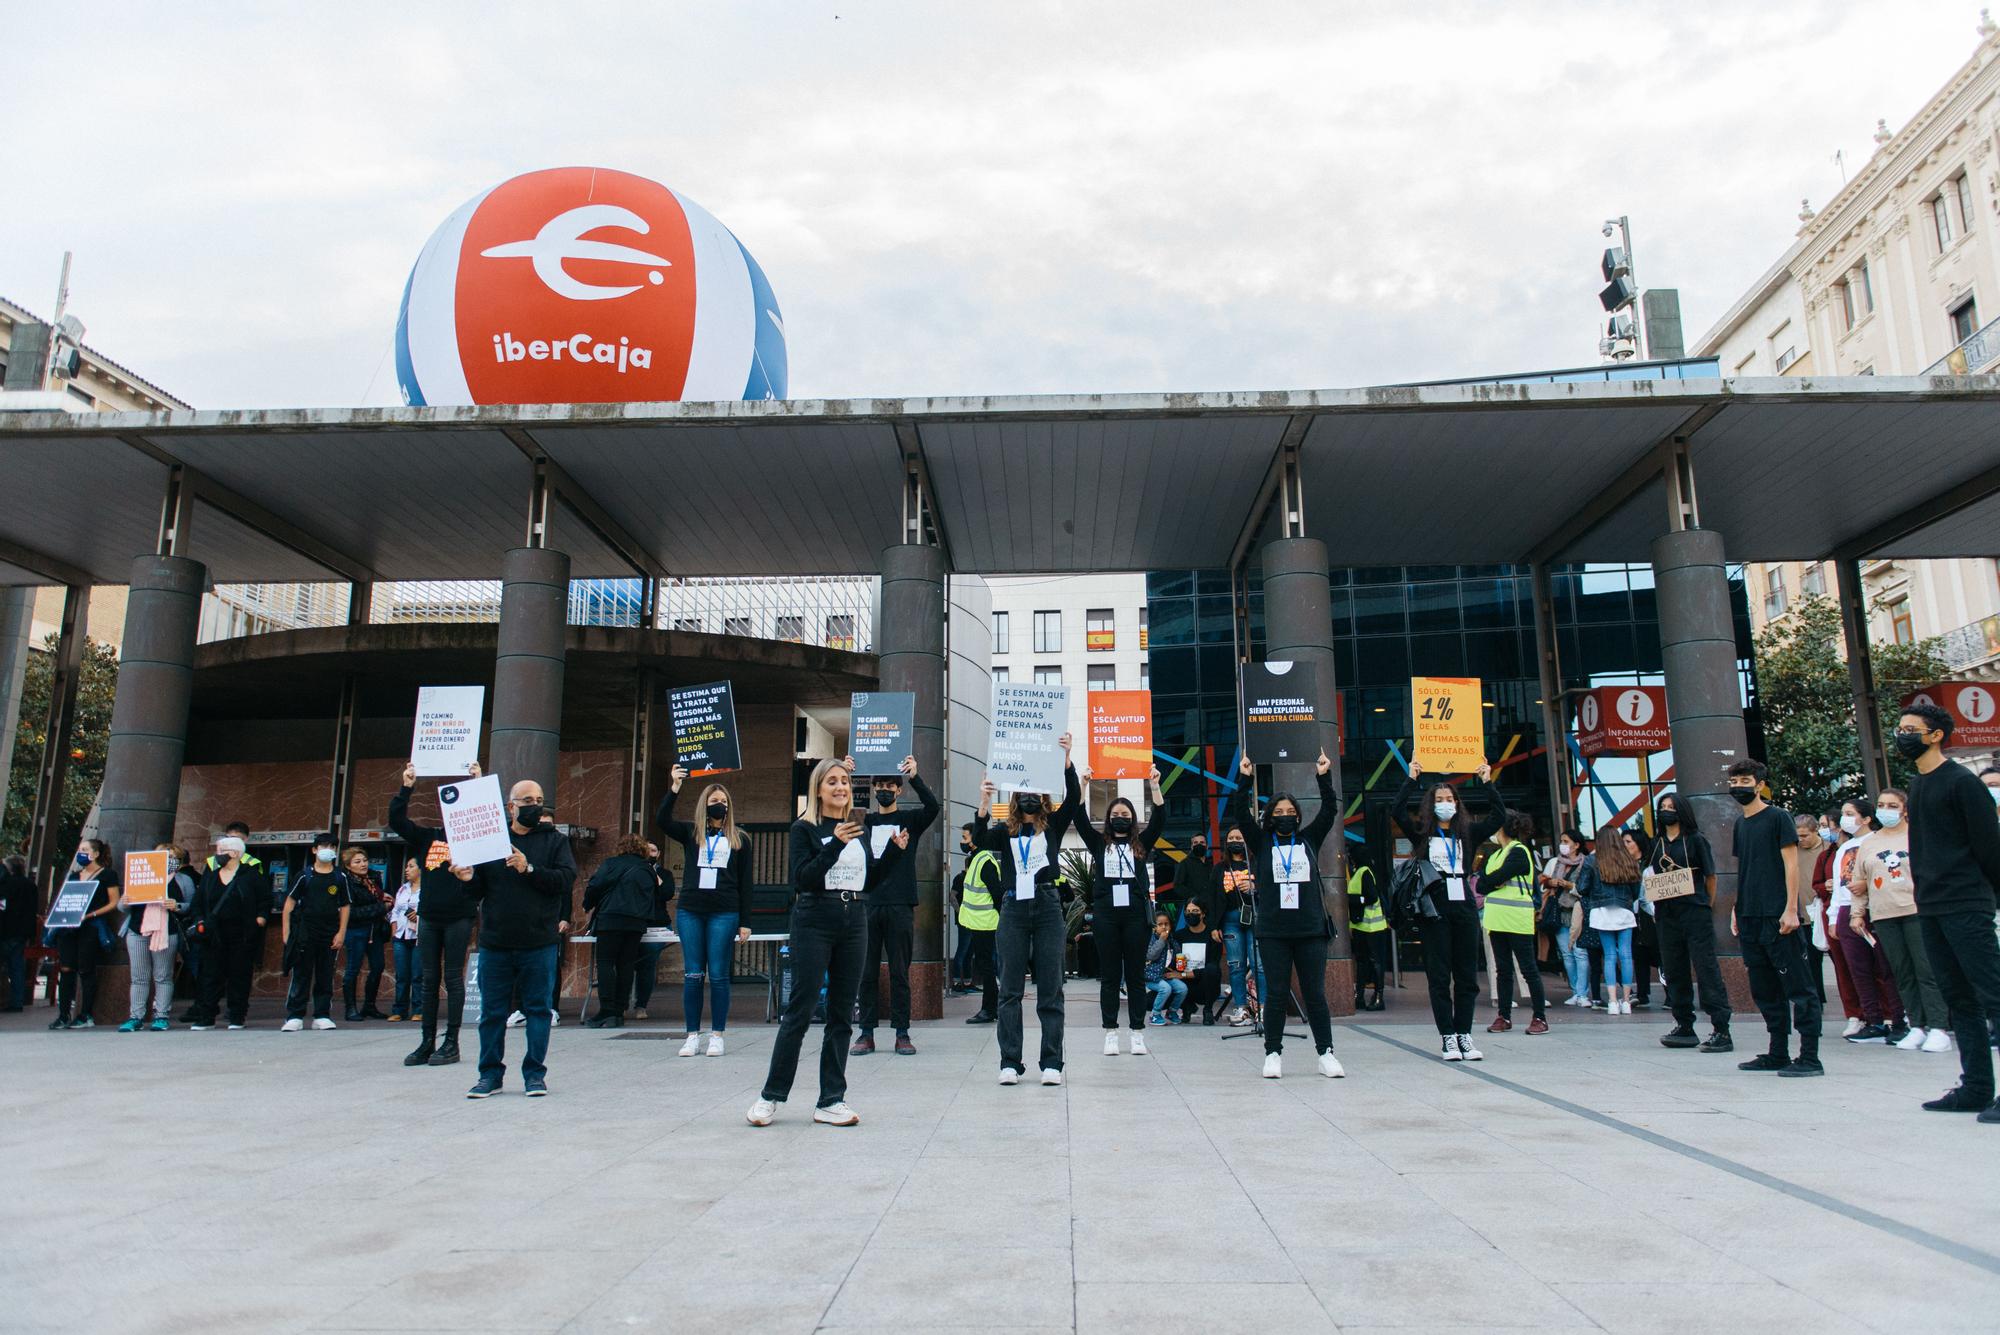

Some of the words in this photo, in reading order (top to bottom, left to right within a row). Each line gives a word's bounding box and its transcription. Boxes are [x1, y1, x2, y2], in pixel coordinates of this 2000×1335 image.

[671, 693, 681, 701] SE
[682, 688, 710, 699] ESTIMA
[711, 686, 727, 694] QUE
[1013, 690, 1045, 698] ESTIMA
[1047, 691, 1065, 699] QUE
[684, 699, 707, 708] TRATA
[708, 696, 719, 704] DE
[1013, 700, 1039, 708] TRATA
[1271, 698, 1305, 706] PERSONAS
[673, 706, 713, 718] PERSONAS
[997, 709, 1044, 719] PERSONAS
[1274, 706, 1314, 714] EXPLOTADAS
[1420, 697, 1454, 721] 1%
[674, 716, 704, 727] GENERA
[706, 713, 722, 722] MÁS
[1258, 714, 1288, 722] NUESTRA
[996, 720, 1031, 729] GENERA
[1433, 723, 1449, 731] LAS
[676, 728, 686, 736] DE
[687, 726, 701, 734] 126
[677, 733, 714, 744] MILLONES
[715, 731, 725, 739] DE
[1009, 732, 1025, 740] 126
[1028, 732, 1042, 741] MIL
[1093, 735, 1144, 744] EXISTIENDO
[678, 743, 703, 753] EUROS
[994, 741, 1038, 751] MILLONES
[1040, 744, 1053, 752] DE
[691, 751, 709, 761] AÑO.
[993, 752, 1023, 761] EUROS
[449, 805, 488, 820] ABOLIENDO
[488, 802, 498, 811] LA
[449, 813, 490, 828] ESCLAVITUD
[453, 825, 470, 835] TODO
[472, 819, 493, 831] LUGAR
[452, 834, 470, 843] PARA
[472, 826, 503, 839] SIEMPRE.
[130, 871, 155, 879] VENDEN
[129, 877, 164, 886] PERSONAS
[1657, 885, 1682, 898] SEXUAL
